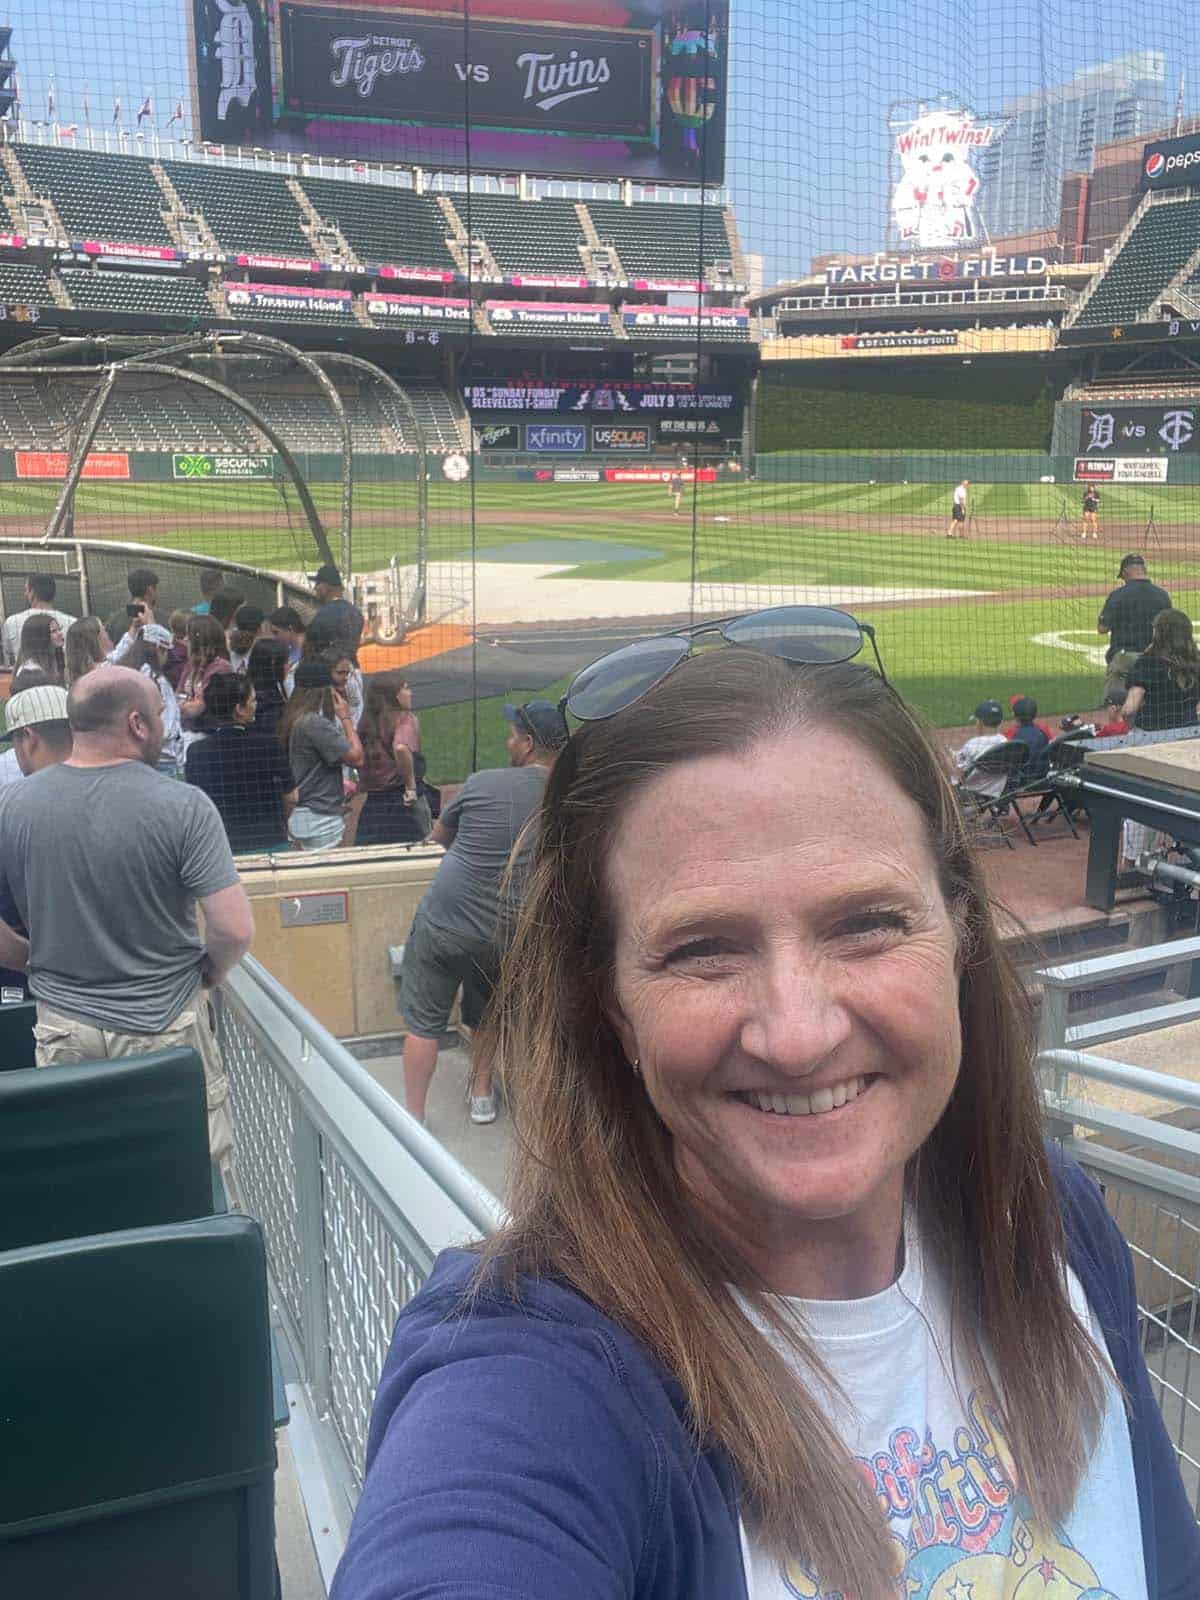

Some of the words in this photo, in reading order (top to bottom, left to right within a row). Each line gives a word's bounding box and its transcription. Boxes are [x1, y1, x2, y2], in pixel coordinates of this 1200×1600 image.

[372, 36, 413, 48] DETROIT
[331, 37, 425, 97] Tigers
[516, 51, 611, 103] Twins
[898, 128, 936, 153] Win!
[937, 121, 992, 145] Twins!
[1166, 150, 1200, 172] peps
[826, 263, 934, 283] TARGET
[963, 257, 1046, 277] FIELD
[255, 294, 306, 309] Treasure
[308, 299, 344, 312] Island
[389, 303, 421, 315] Home
[422, 305, 443, 317] Run
[444, 307, 470, 319] Deck
[566, 313, 600, 323] Island
[658, 315, 689, 325] Home
[712, 317, 738, 327] Deck
[472, 398, 524, 408] SLEEVELESS
[525, 399, 558, 409] T-SHIRT
[640, 393, 665, 408] JULY
[667, 395, 675, 408] 9
[530, 428, 582, 448] xfinity
